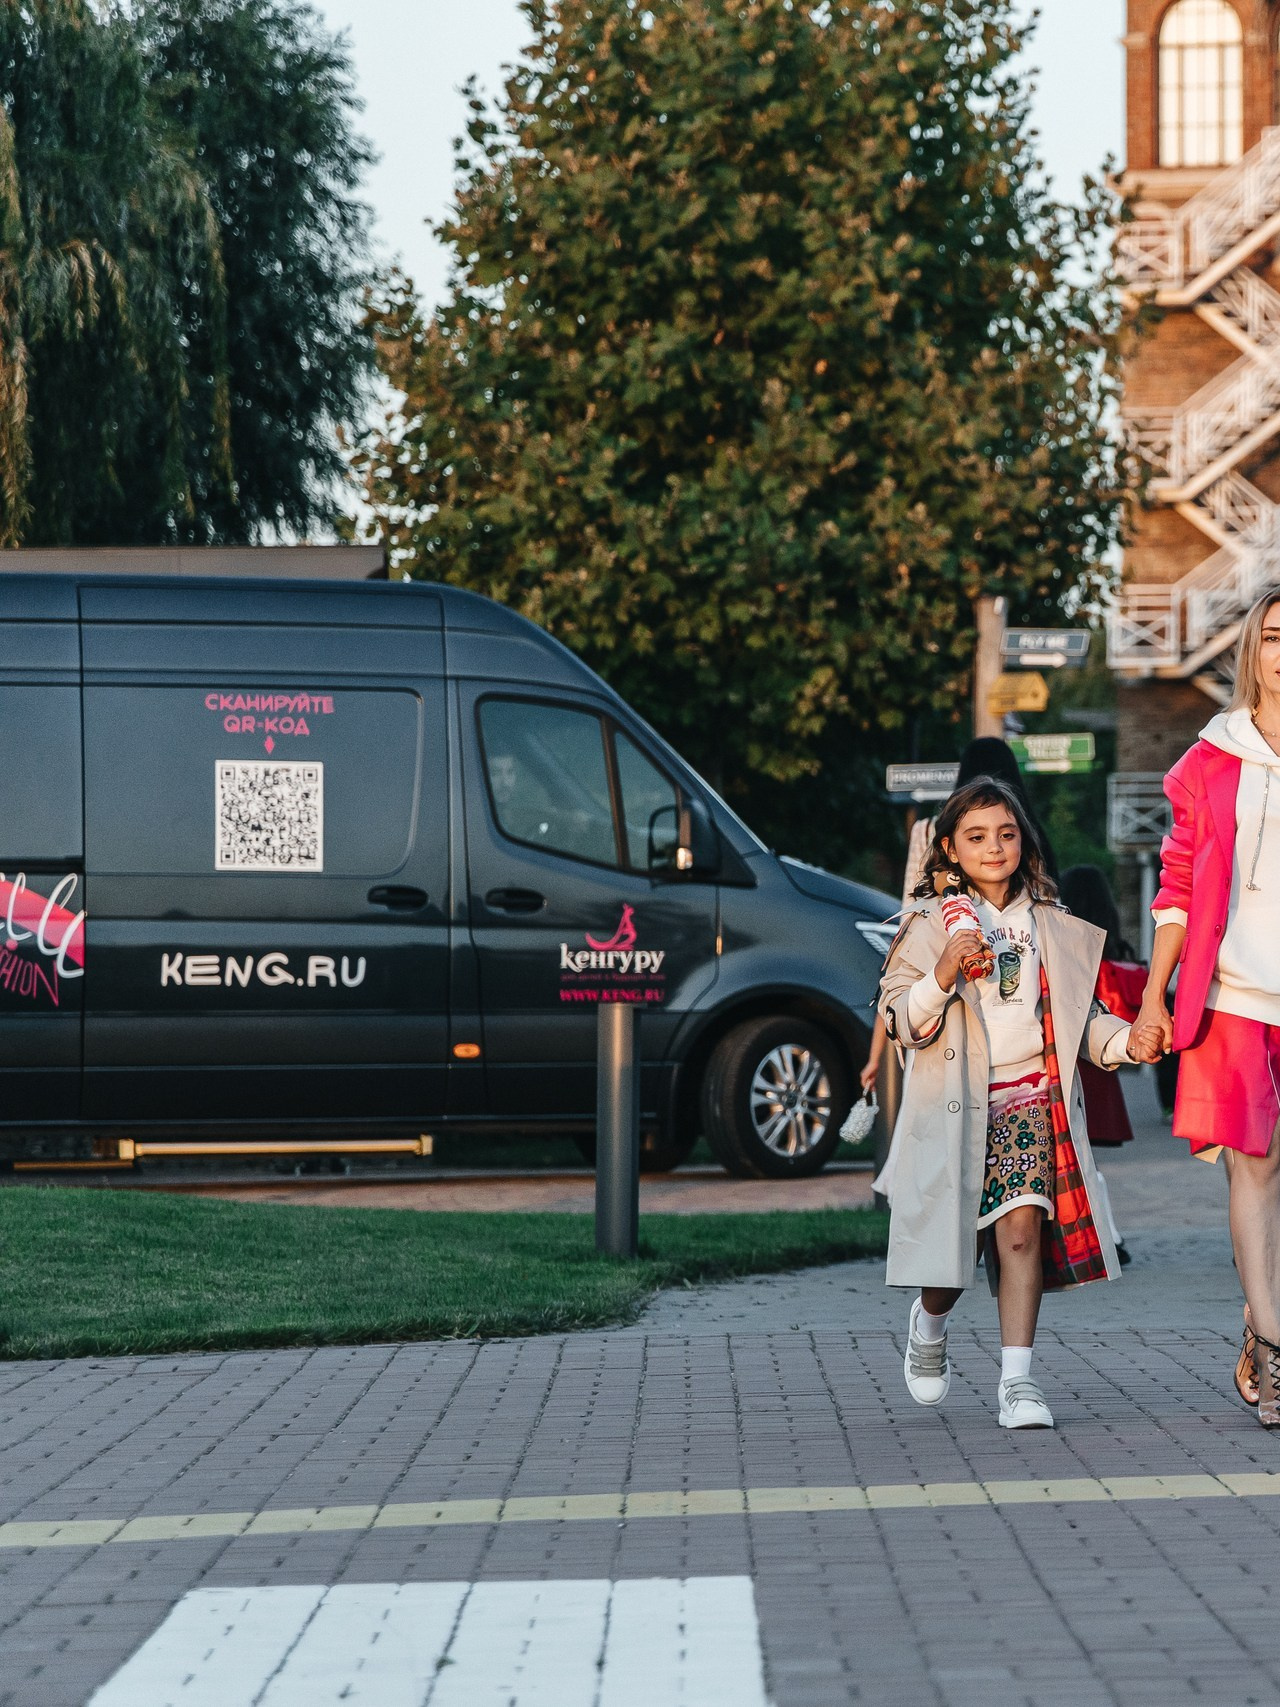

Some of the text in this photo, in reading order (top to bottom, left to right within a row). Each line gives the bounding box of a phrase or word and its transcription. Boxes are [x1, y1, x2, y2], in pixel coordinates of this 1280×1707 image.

[204, 692, 335, 714] СКАНИРУЙТЕ
[223, 714, 310, 736] QR-КОД
[986, 927, 1007, 949] OTCH
[1008, 926, 1016, 941] &
[160, 951, 367, 988] KENG.RU
